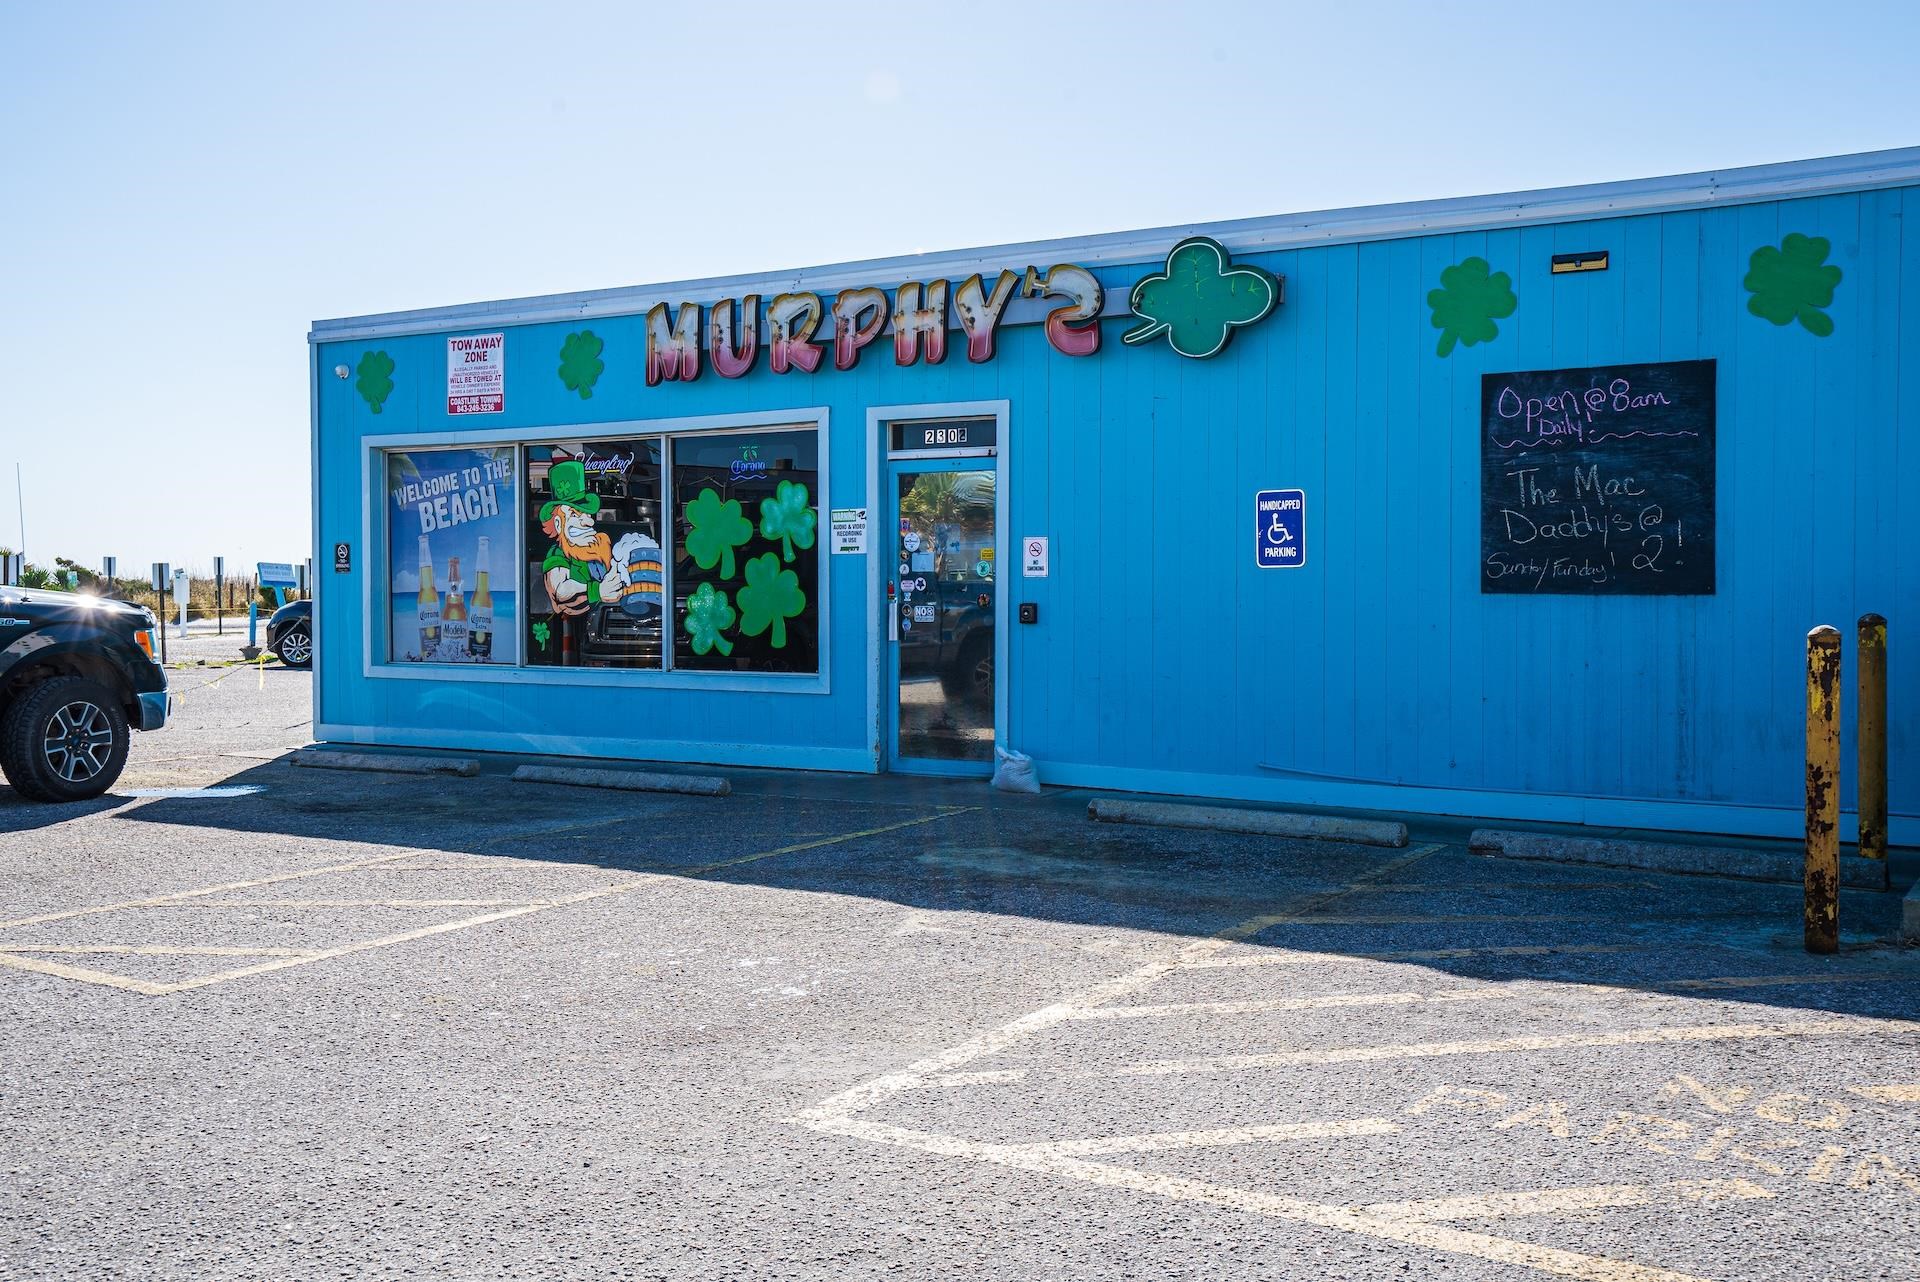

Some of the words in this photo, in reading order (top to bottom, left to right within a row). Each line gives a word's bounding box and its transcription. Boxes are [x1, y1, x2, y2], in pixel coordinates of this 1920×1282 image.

[645, 263, 1102, 387] MURPHY'S
[451, 340, 472, 351] TOW
[474, 337, 502, 349] AWAY
[464, 351, 488, 363] ZONE
[450, 397, 480, 405] COASTLINE
[480, 395, 502, 403] TOWING
[1498, 386, 1581, 432] Open
[926, 428, 967, 443] 2302
[394, 472, 460, 506] WELCOME
[462, 466, 481, 487] TO
[483, 458, 512, 481] THE
[1506, 468, 1560, 508] The
[1574, 464, 1646, 505] Mac
[418, 484, 500, 534] BEACH
[1260, 499, 1301, 511] HANDICAPPED
[1500, 504, 1633, 548] Daddy's
[1264, 546, 1297, 558] PARKING
